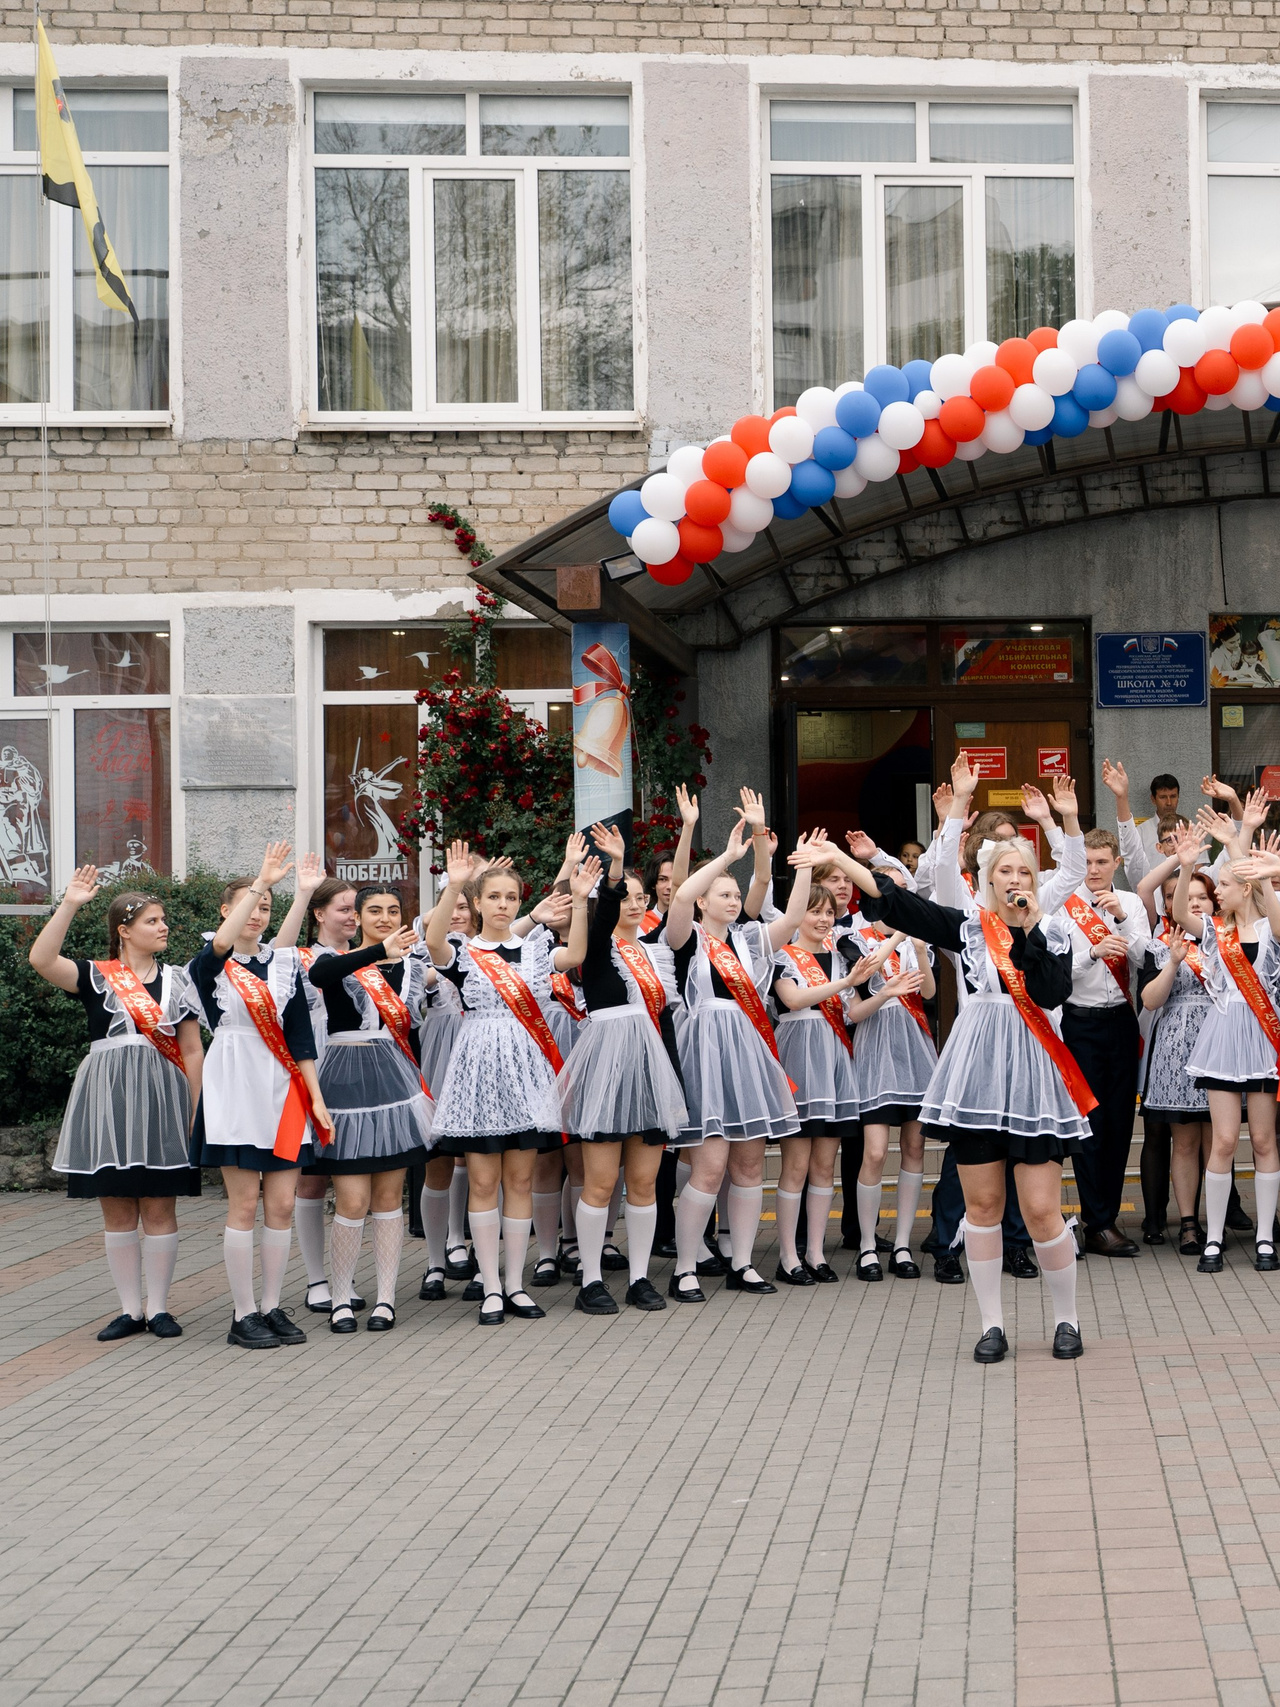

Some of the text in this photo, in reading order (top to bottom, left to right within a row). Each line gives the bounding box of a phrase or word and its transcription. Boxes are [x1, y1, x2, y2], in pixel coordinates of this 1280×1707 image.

[1117, 680, 1187, 688] ШКОЛА № 40
[336, 864, 408, 883] ПОБЕДА!
